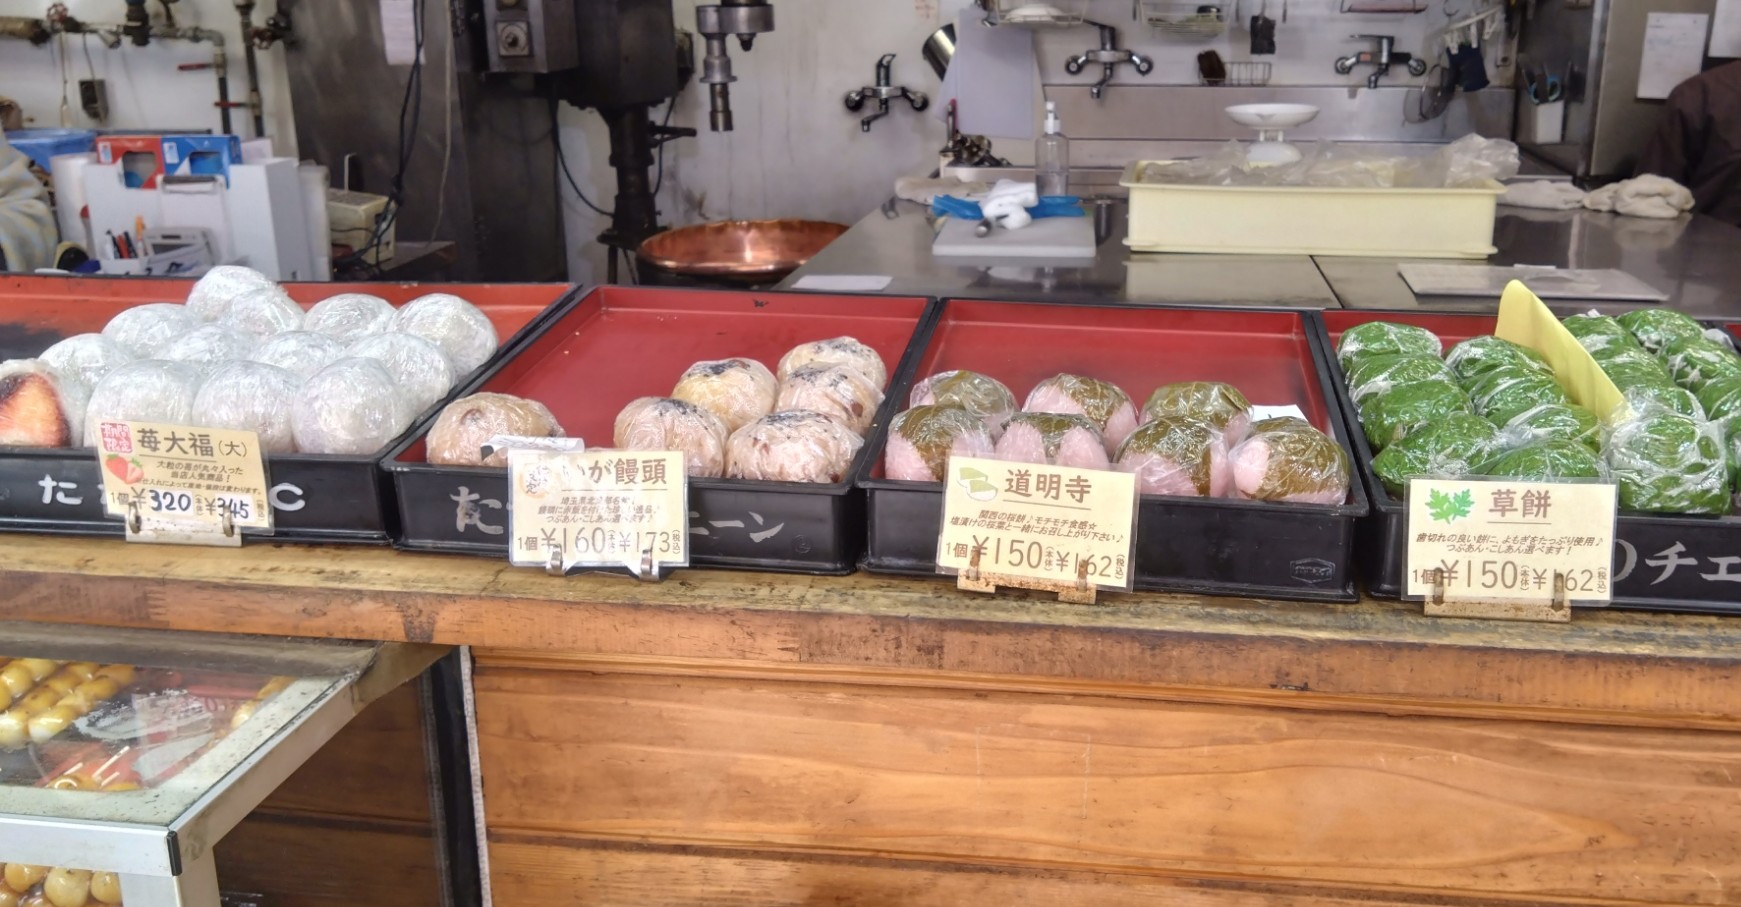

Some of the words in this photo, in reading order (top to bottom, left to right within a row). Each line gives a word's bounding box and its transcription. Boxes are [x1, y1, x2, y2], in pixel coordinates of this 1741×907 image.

[1004, 469, 1092, 503] 道明寺
[1488, 489, 1552, 518] 草餅
